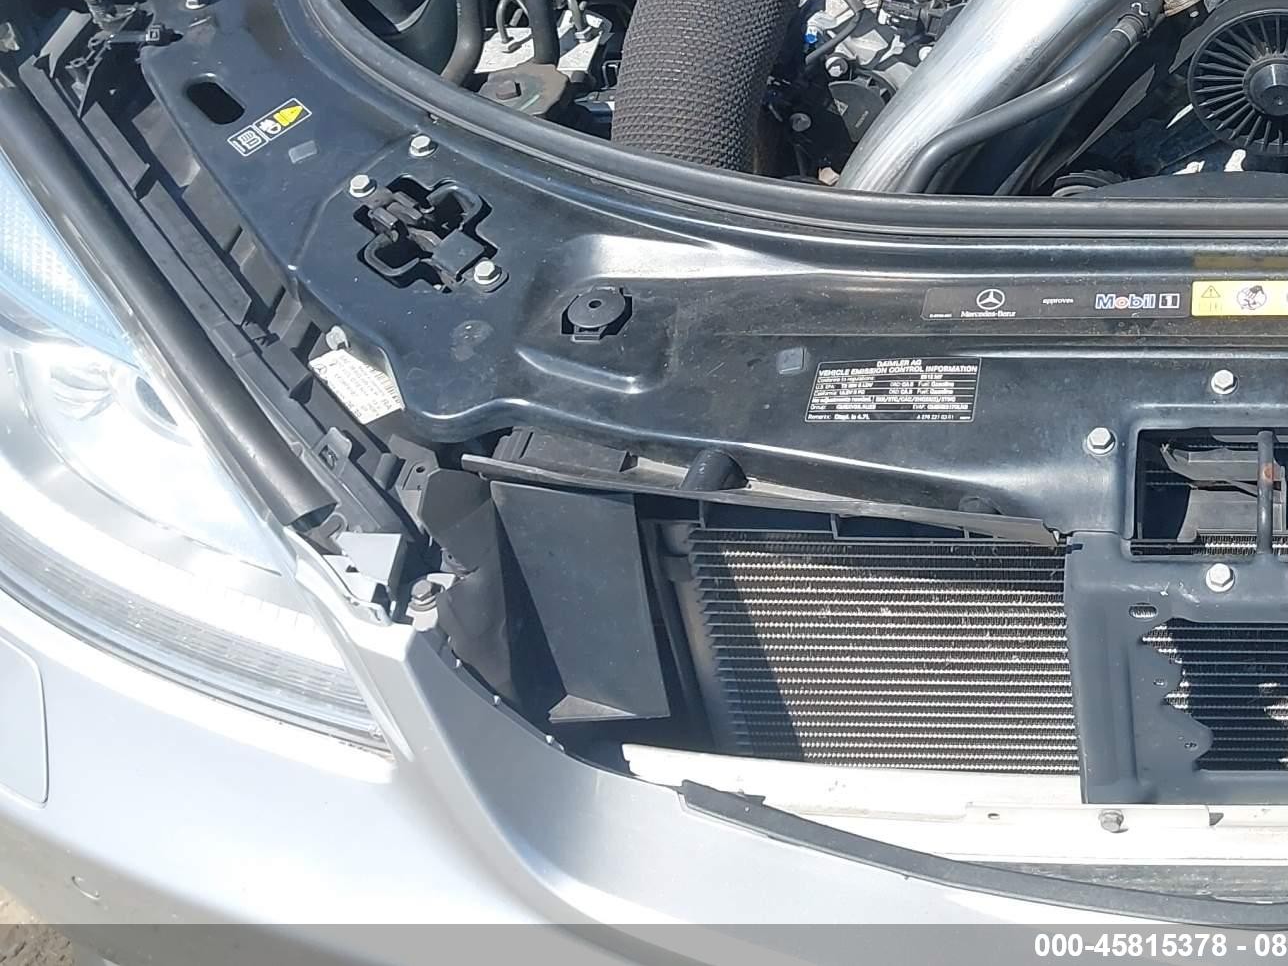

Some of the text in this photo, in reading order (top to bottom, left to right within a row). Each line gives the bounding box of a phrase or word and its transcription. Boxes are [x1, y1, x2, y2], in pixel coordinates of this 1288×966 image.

[960, 311, 1016, 319] Mercedes-Benz
[1095, 293, 1157, 310] Mobil
[877, 360, 911, 368] DAIMLER
[889, 366, 924, 374] CONTROL
[925, 365, 978, 373] INFORMATION
